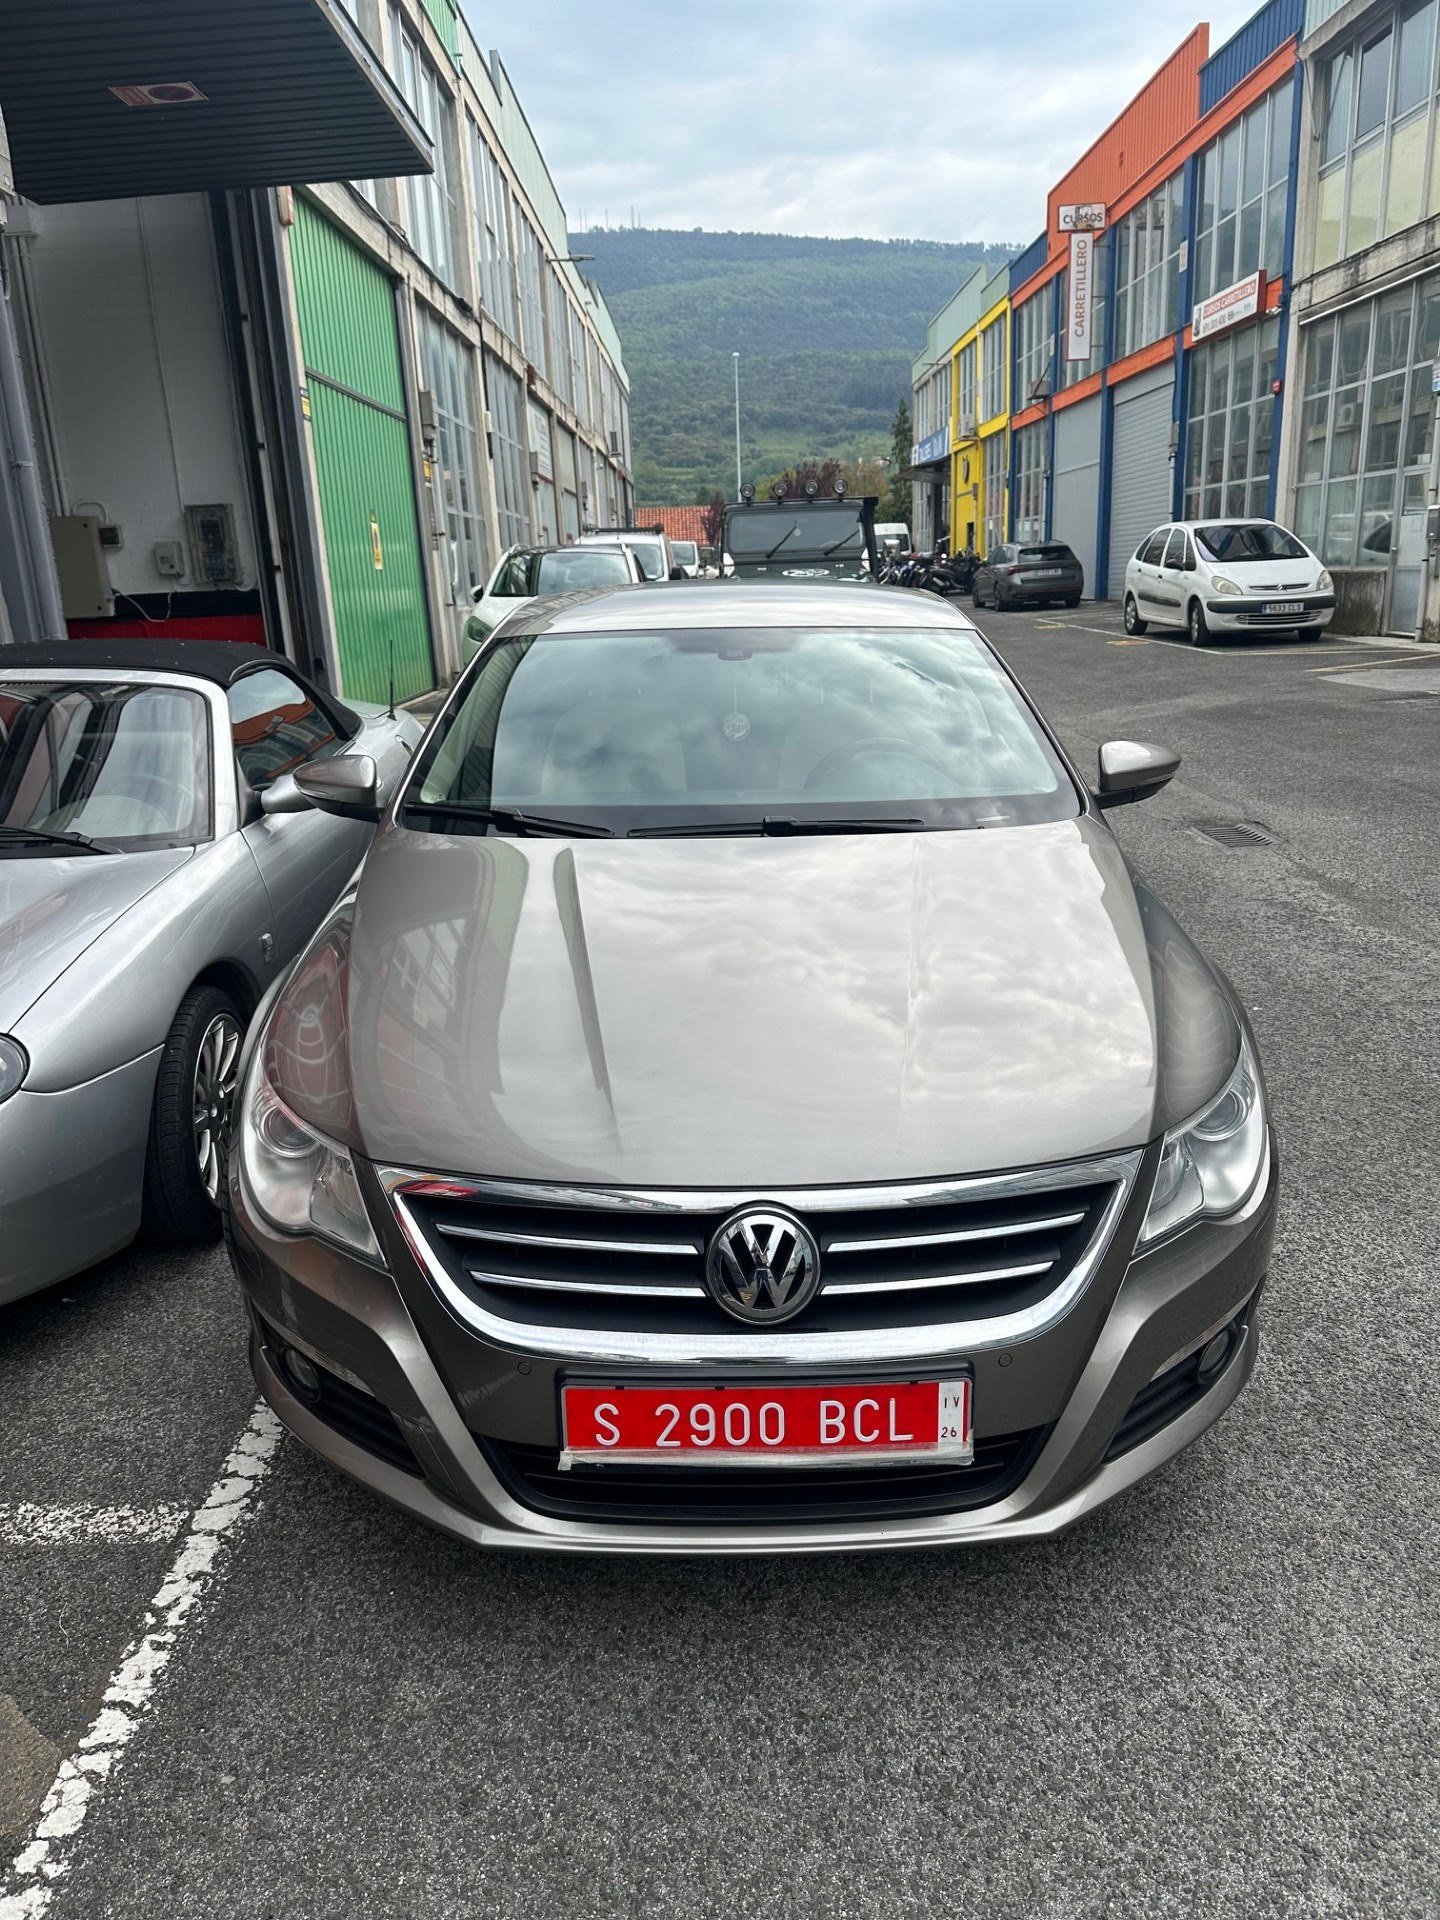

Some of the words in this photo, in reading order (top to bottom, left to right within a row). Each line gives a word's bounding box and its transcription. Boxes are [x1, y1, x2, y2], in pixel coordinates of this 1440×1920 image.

[1063, 212, 1103, 225] CURSOS
[1074, 239, 1087, 338] CARRETILLERO
[593, 1403, 621, 1446] S
[655, 1402, 785, 1447] 2900
[820, 1397, 914, 1444] BCL
[941, 1426, 957, 1438] 26
